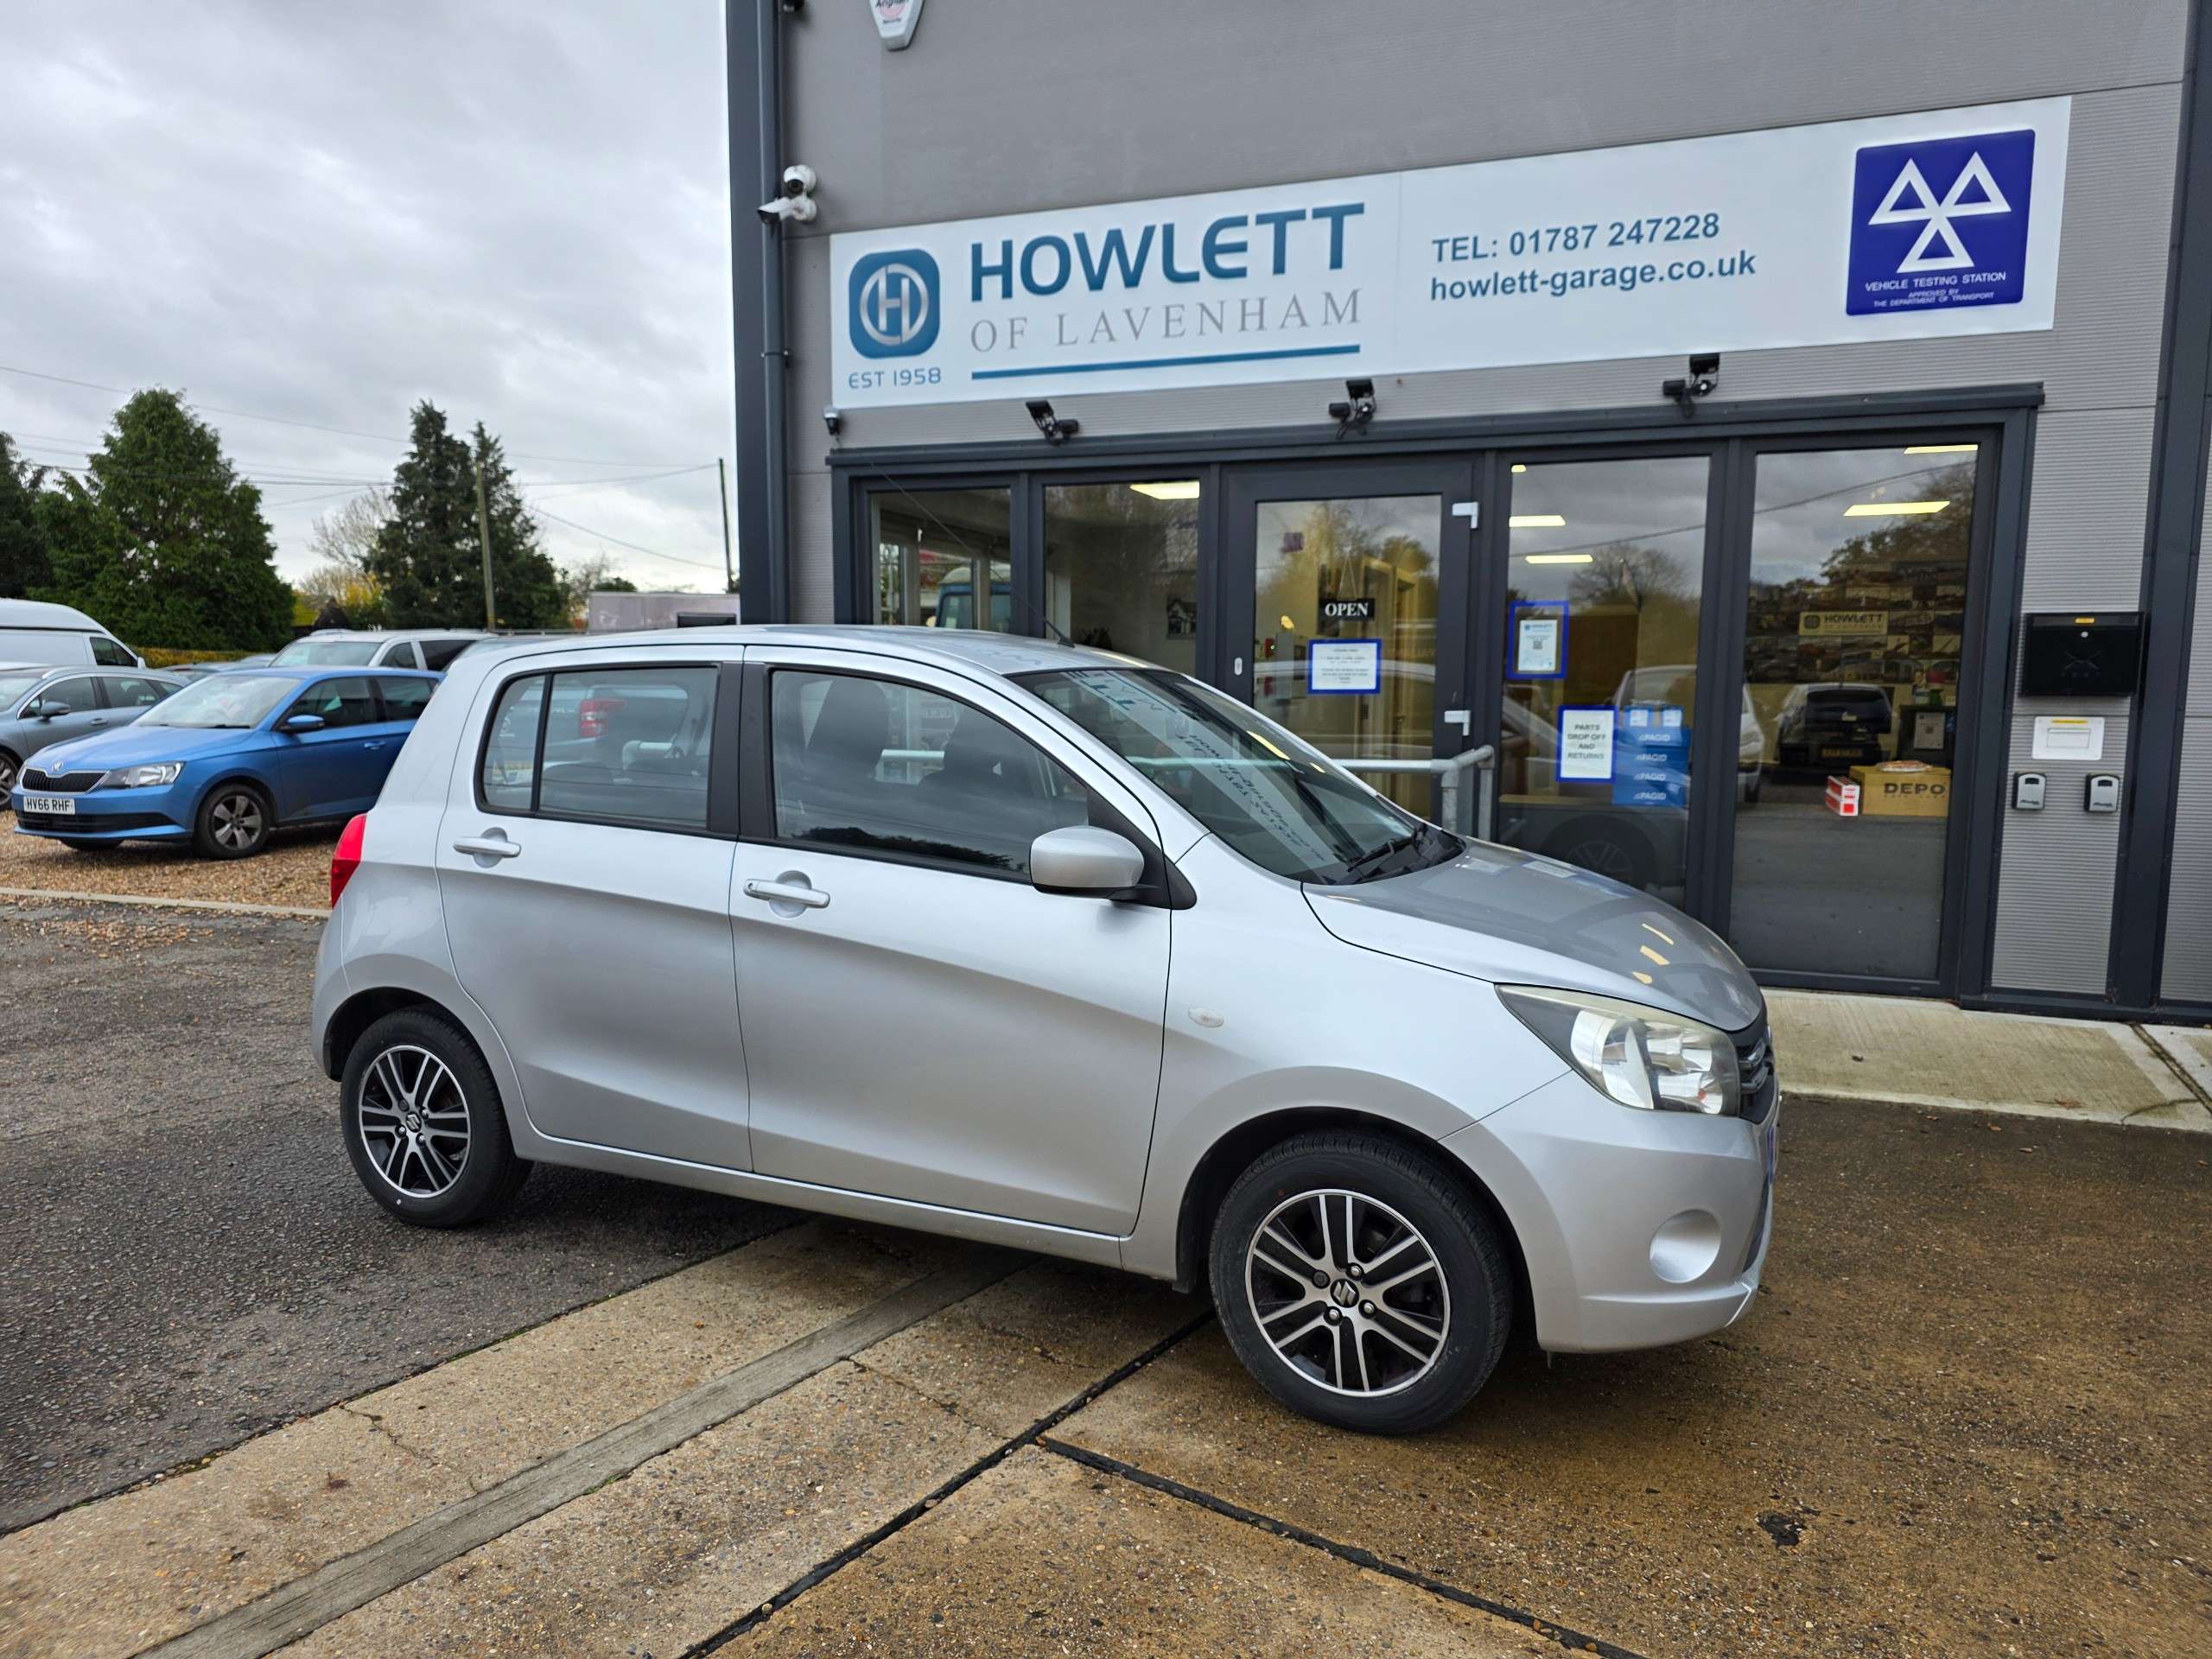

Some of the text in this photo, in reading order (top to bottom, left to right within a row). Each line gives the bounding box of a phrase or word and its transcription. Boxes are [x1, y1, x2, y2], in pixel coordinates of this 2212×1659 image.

[1432, 213, 1719, 263] TEL: 01787 247228
[970, 202, 1364, 302] HOWLETT
[1431, 250, 1757, 301] howlett-garage.co.uk
[1865, 271, 2006, 292] VEHICLE TESTING STATION
[1952, 292, 1995, 302] TRANSPORT
[971, 289, 1361, 353] OF LAVENHAM
[849, 366, 941, 389] EST 1958
[1325, 601, 1369, 617] OPEN
[1884, 783, 1946, 795] DEPO
[27, 798, 70, 811] HV66 RHF
